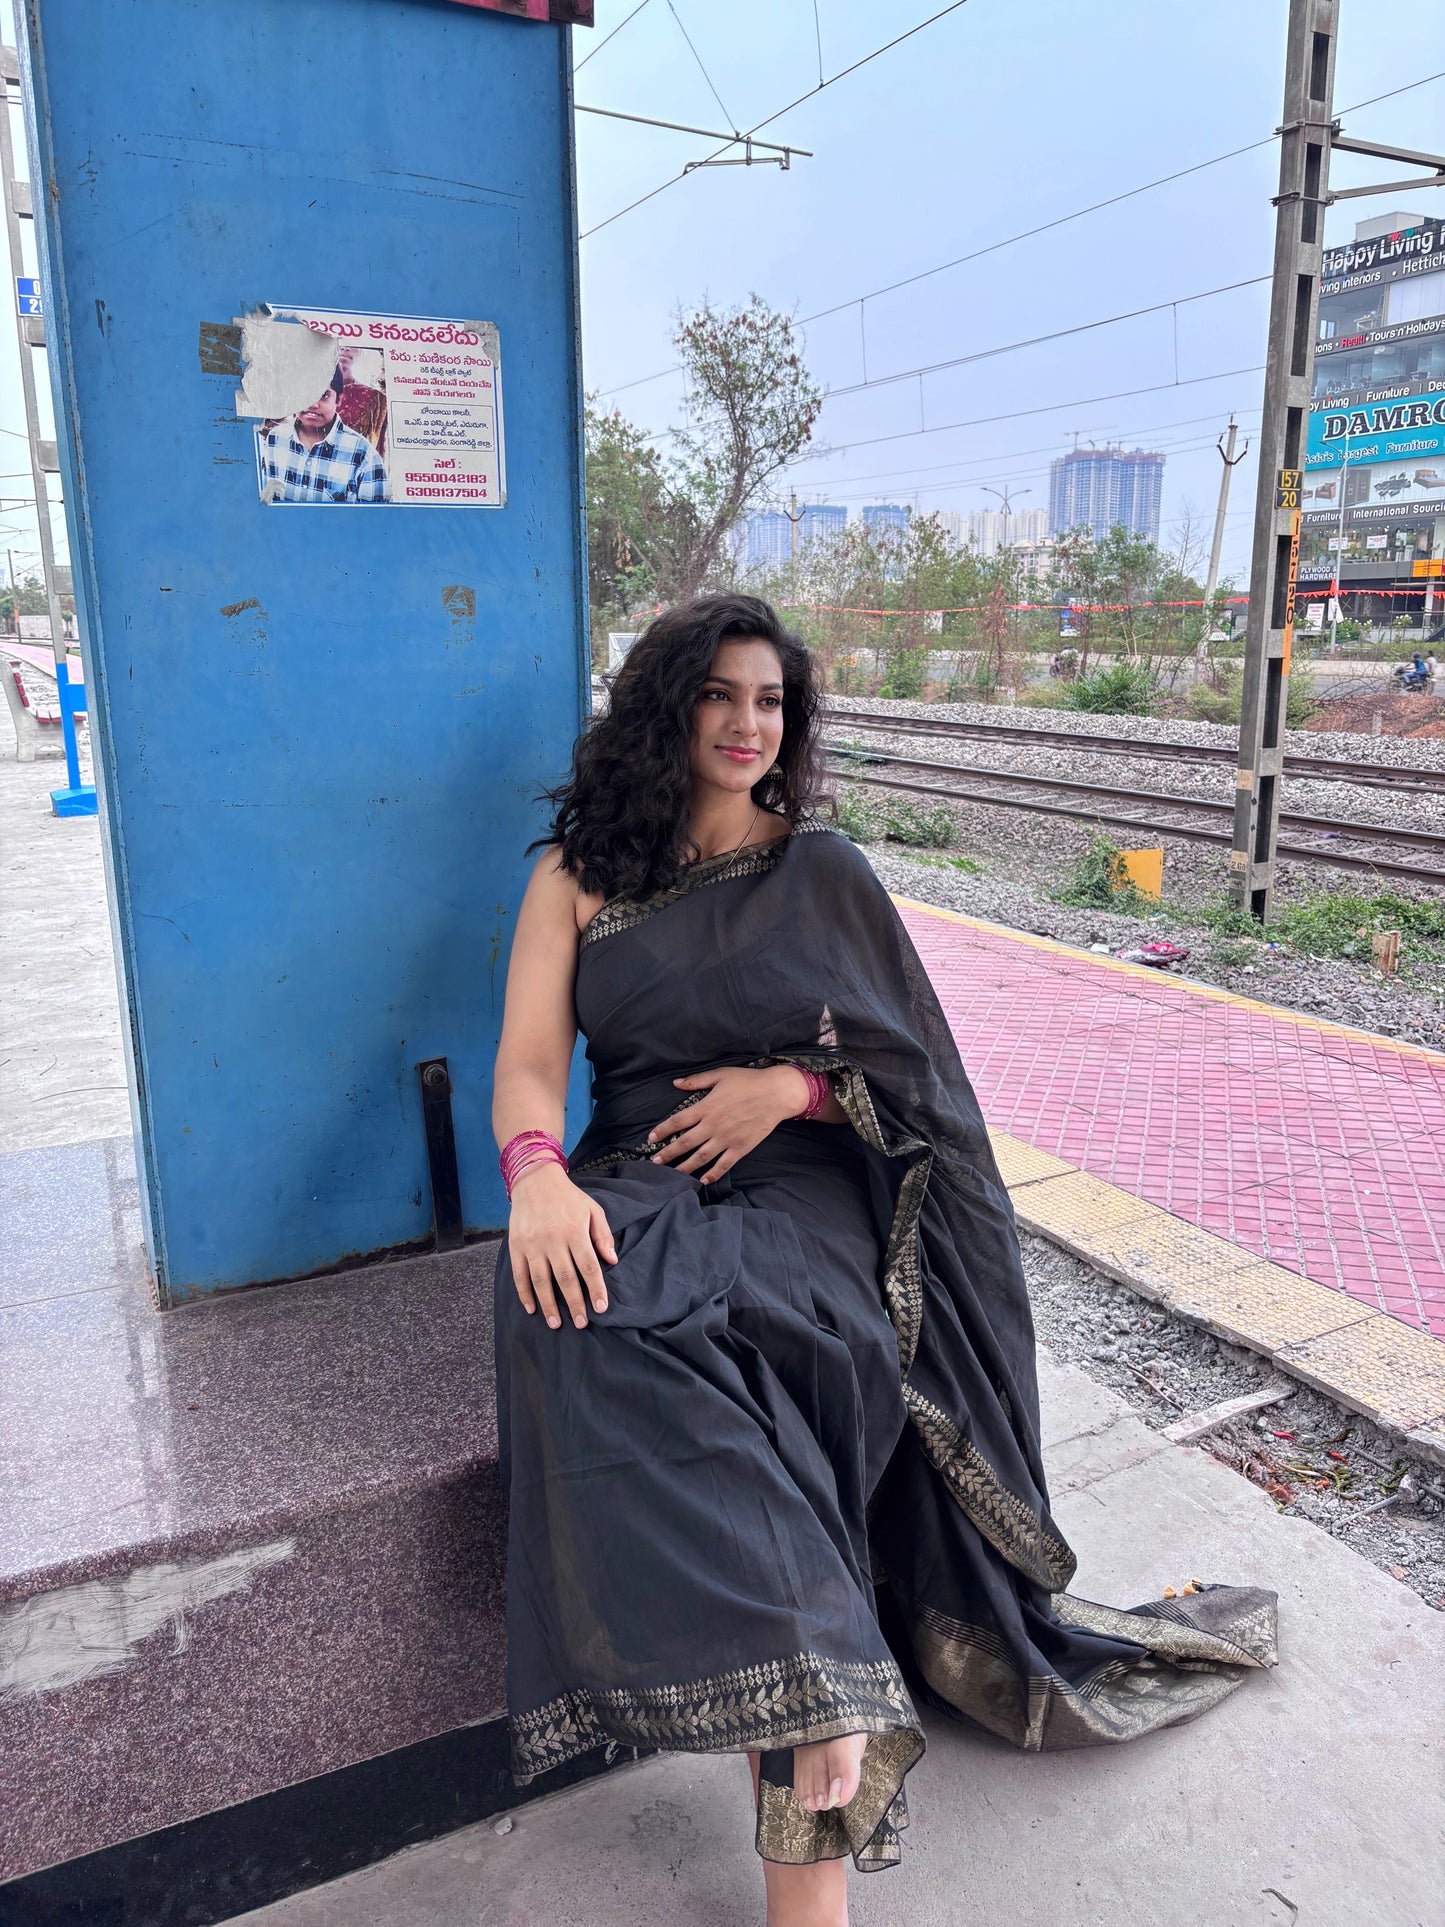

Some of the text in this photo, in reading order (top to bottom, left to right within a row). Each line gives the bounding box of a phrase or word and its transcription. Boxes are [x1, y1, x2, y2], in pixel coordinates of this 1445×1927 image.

[1322, 244, 1378, 273] Happy
[1380, 228, 1433, 259] Living
[1342, 272, 1381, 289] interiors
[1402, 252, 1445, 275] Hettich
[29, 298, 43, 314] 2
[368, 323, 479, 346] కనబడలేదు
[389, 349, 411, 362] పేరు
[463, 355, 492, 367] సాయి
[1322, 395, 1350, 409] Living
[1366, 386, 1410, 402] Furniture
[1386, 439, 1438, 454] Furniture
[433, 458, 456, 469] సెల్
[405, 472, 487, 484] 9550042183
[1281, 471, 1299, 488] 157
[406, 487, 487, 498] 6309137504
[1281, 490, 1297, 507] 20
[1353, 505, 1409, 519] International
